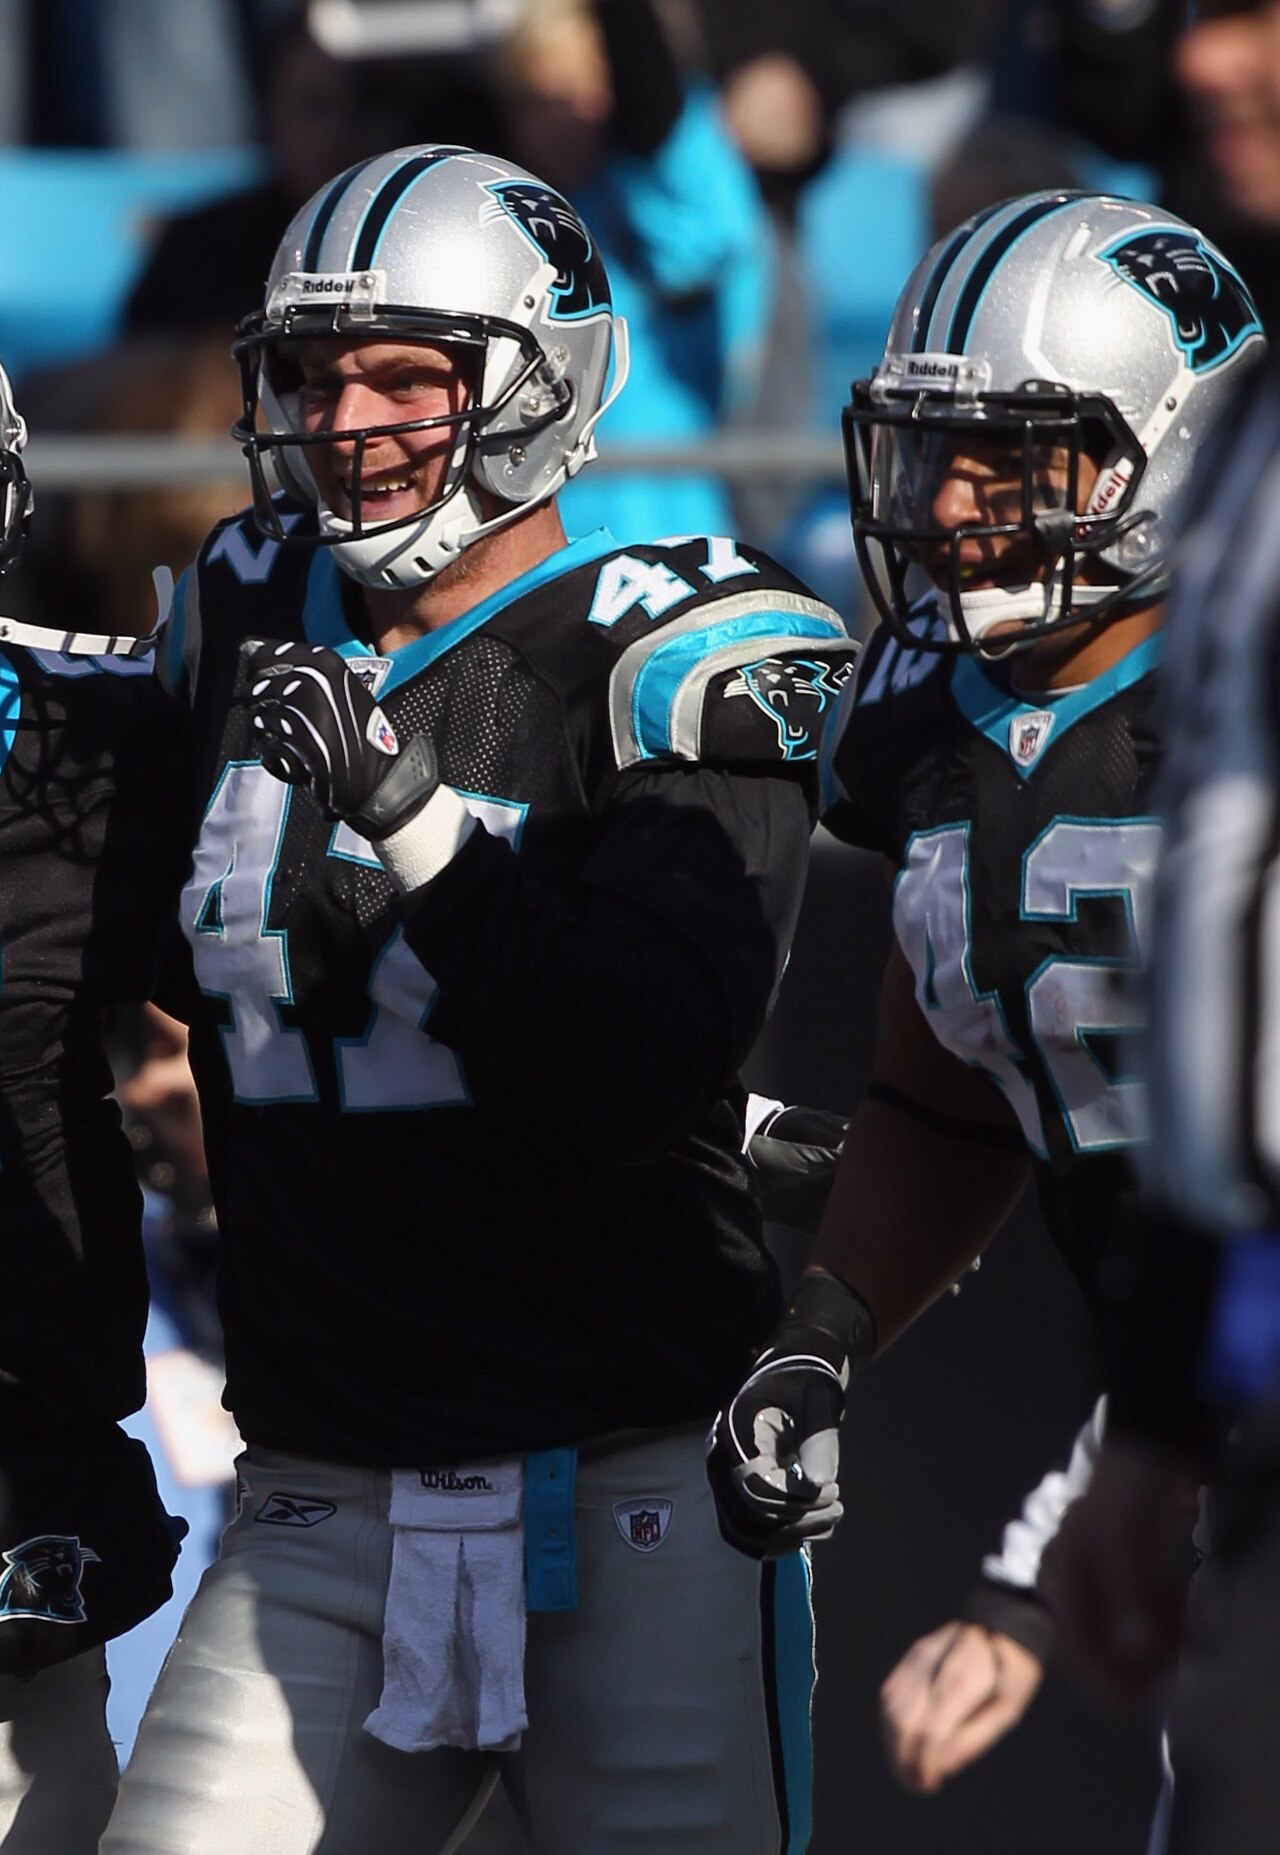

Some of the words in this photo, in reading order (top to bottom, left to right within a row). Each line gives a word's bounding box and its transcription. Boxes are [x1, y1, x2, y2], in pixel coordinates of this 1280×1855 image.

[302, 279, 356, 293] Riddell
[586, 535, 760, 628] 47
[418, 1469, 492, 1490] Wilson
